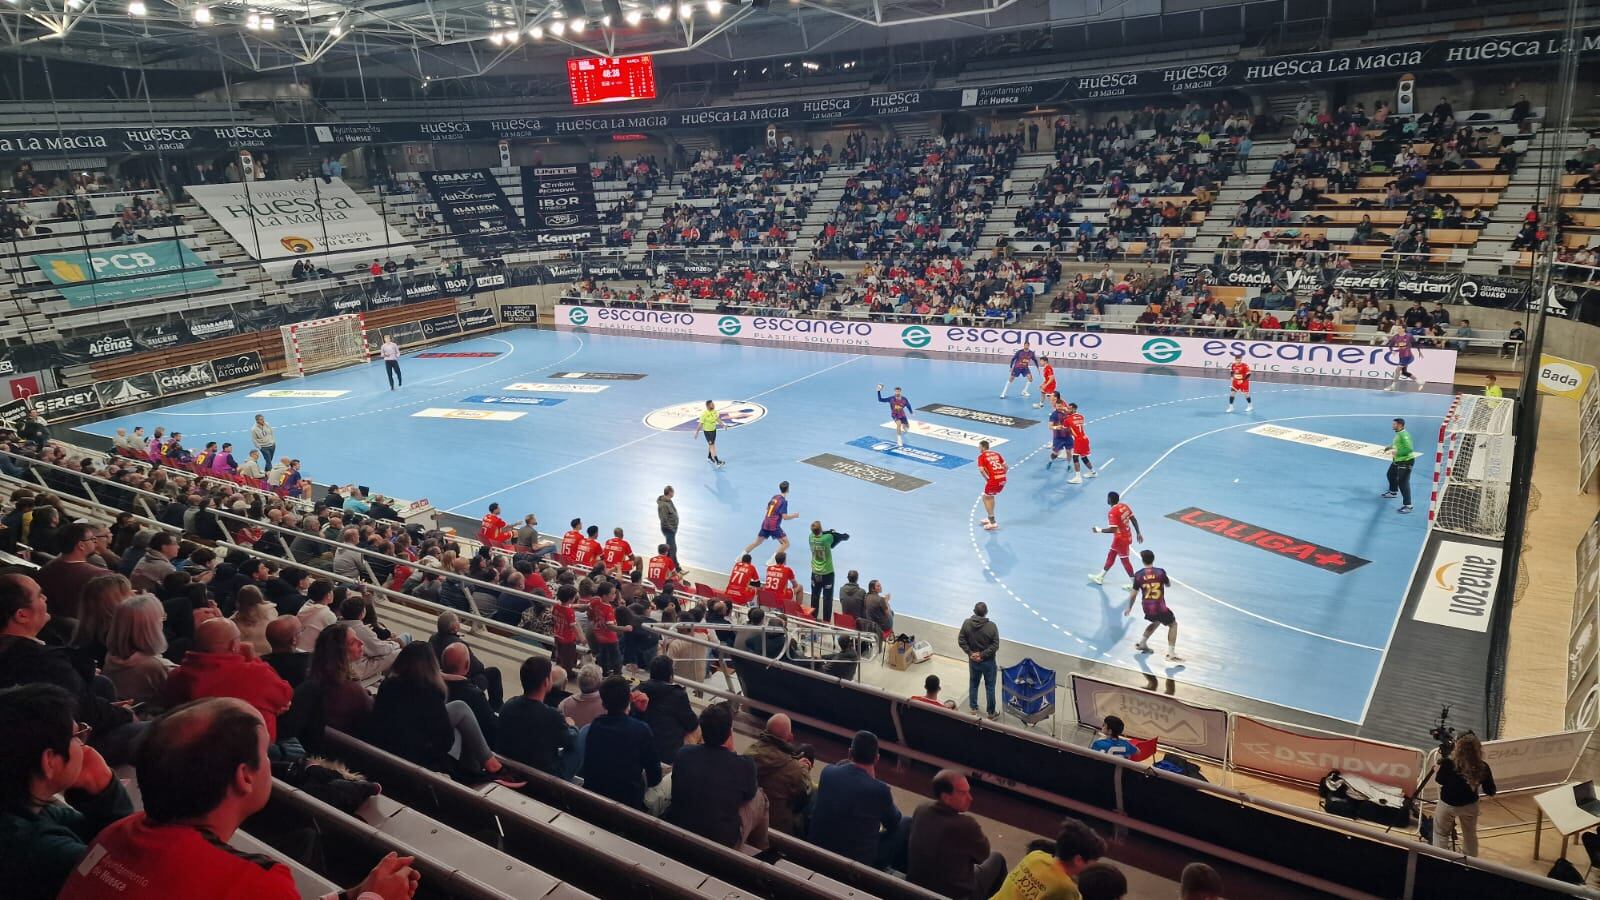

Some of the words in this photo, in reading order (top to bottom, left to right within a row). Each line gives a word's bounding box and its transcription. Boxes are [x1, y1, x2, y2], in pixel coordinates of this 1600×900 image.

[1446, 40, 1540, 62] Huesca
[1164, 64, 1228, 82] Huesca
[1246, 59, 1322, 79] Huesca
[1078, 74, 1137, 89] Huesca
[980, 86, 1033, 96] Ayuntamiento
[803, 99, 850, 112] Huesca
[871, 93, 920, 107] Huesca
[990, 96, 1018, 104] Huesca
[681, 111, 730, 124] Huesca
[420, 122, 472, 133] Huesca
[491, 119, 541, 130] Huesca
[556, 119, 608, 131] Huesca
[126, 128, 192, 142] Huesca
[214, 126, 273, 138] Huesca
[345, 134, 371, 142] Huesca
[222, 196, 355, 219] Huesca
[539, 196, 579, 206] IBOR
[537, 232, 591, 243] Kempa
[87, 252, 156, 273] PCB
[444, 279, 468, 289] IBOR
[1334, 276, 1389, 288] SERFEY
[1398, 280, 1451, 294] seytam
[406, 285, 437, 295] ALAMEDA
[334, 299, 361, 309] Kempa
[503, 309, 534, 317] Huesca
[598, 308, 694, 325] escanero
[600, 322, 635, 330] PLASTIC
[640, 324, 693, 334] SOLUTIONS
[753, 317, 872, 336] escanero
[754, 332, 796, 341] PLASTIC
[804, 335, 870, 346] SOLUTIONS
[947, 327, 1103, 349] escanero
[89, 338, 133, 354] Arenas
[948, 345, 1004, 354] PLASTIC
[1204, 340, 1415, 367] escanero
[1204, 359, 1280, 372] PLATIC
[1542, 368, 1578, 387] Bada
[35, 391, 93, 412] SERFEY
[1180, 510, 1346, 567] LALIGA+
[731, 571, 744, 584] 71
[766, 577, 780, 590] 33
[1142, 583, 1161, 600] 23
[1448, 555, 1497, 617] amazon
[101, 871, 127, 890] Huesca
